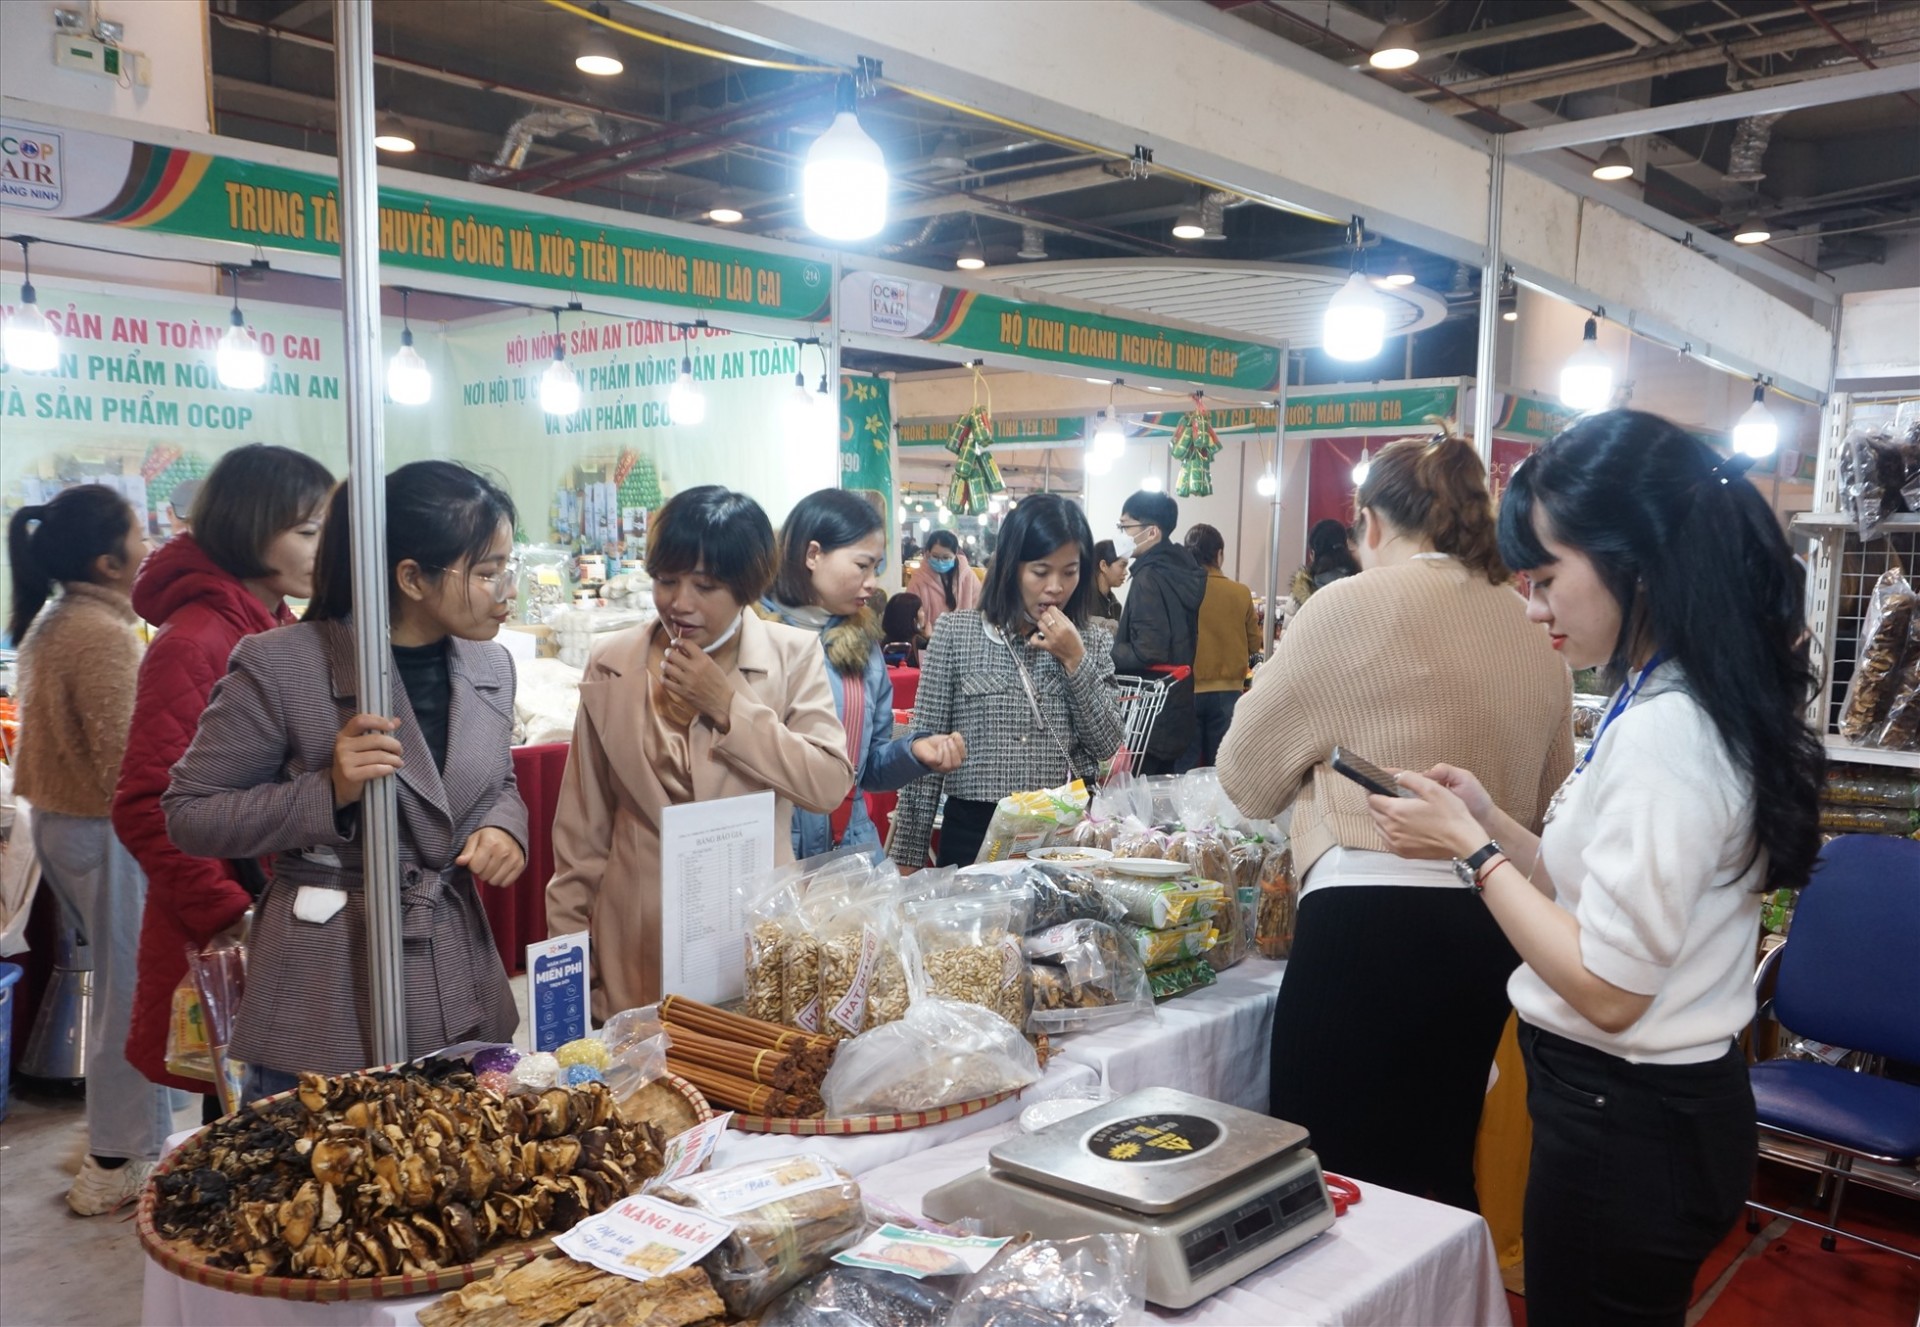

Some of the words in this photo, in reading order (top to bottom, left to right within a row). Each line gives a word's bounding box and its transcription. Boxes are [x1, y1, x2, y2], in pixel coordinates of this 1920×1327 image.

[30, 188, 59, 201] NINH
[225, 181, 305, 239] TRUNG
[311, 190, 340, 245] TÂ
[451, 215, 504, 268] CÔNG
[509, 224, 535, 272] VÀ
[539, 229, 575, 278] XÚC
[580, 230, 617, 283] TIẾN
[622, 246, 687, 294] THƯƠNG
[692, 257, 721, 304] MẠI
[726, 258, 753, 303] LÀO
[757, 268, 781, 308] CAI
[805, 269, 820, 282] 214
[44, 302, 102, 340] SẢN
[111, 316, 148, 344] AN
[283, 334, 321, 361] CAI
[507, 334, 528, 368] HỘI
[531, 331, 566, 361] NÔNG
[571, 320, 598, 355] SẢN
[602, 323, 622, 351] AN
[1001, 310, 1023, 351] HỘ
[1028, 317, 1064, 352] KINH
[1069, 325, 1117, 361] DOANH
[1122, 332, 1173, 369] NGUYỄN
[1176, 341, 1206, 374] ĐÌNH
[87, 348, 166, 386] PHẨM
[308, 375, 339, 400] AN
[463, 379, 485, 406] NƠI
[489, 375, 509, 408] HỘI
[512, 377, 526, 405] TỤ
[589, 353, 630, 391] PHẨM
[635, 355, 676, 387] NÔNG
[692, 346, 715, 381] ẢN
[721, 351, 744, 379] AN
[750, 341, 795, 377] TOÀN
[34, 385, 92, 421] SẢN
[102, 390, 178, 426] PHẨM
[187, 404, 252, 430] OCOP
[596, 394, 637, 430] PHẨM
[1381, 399, 1403, 421] GIA
